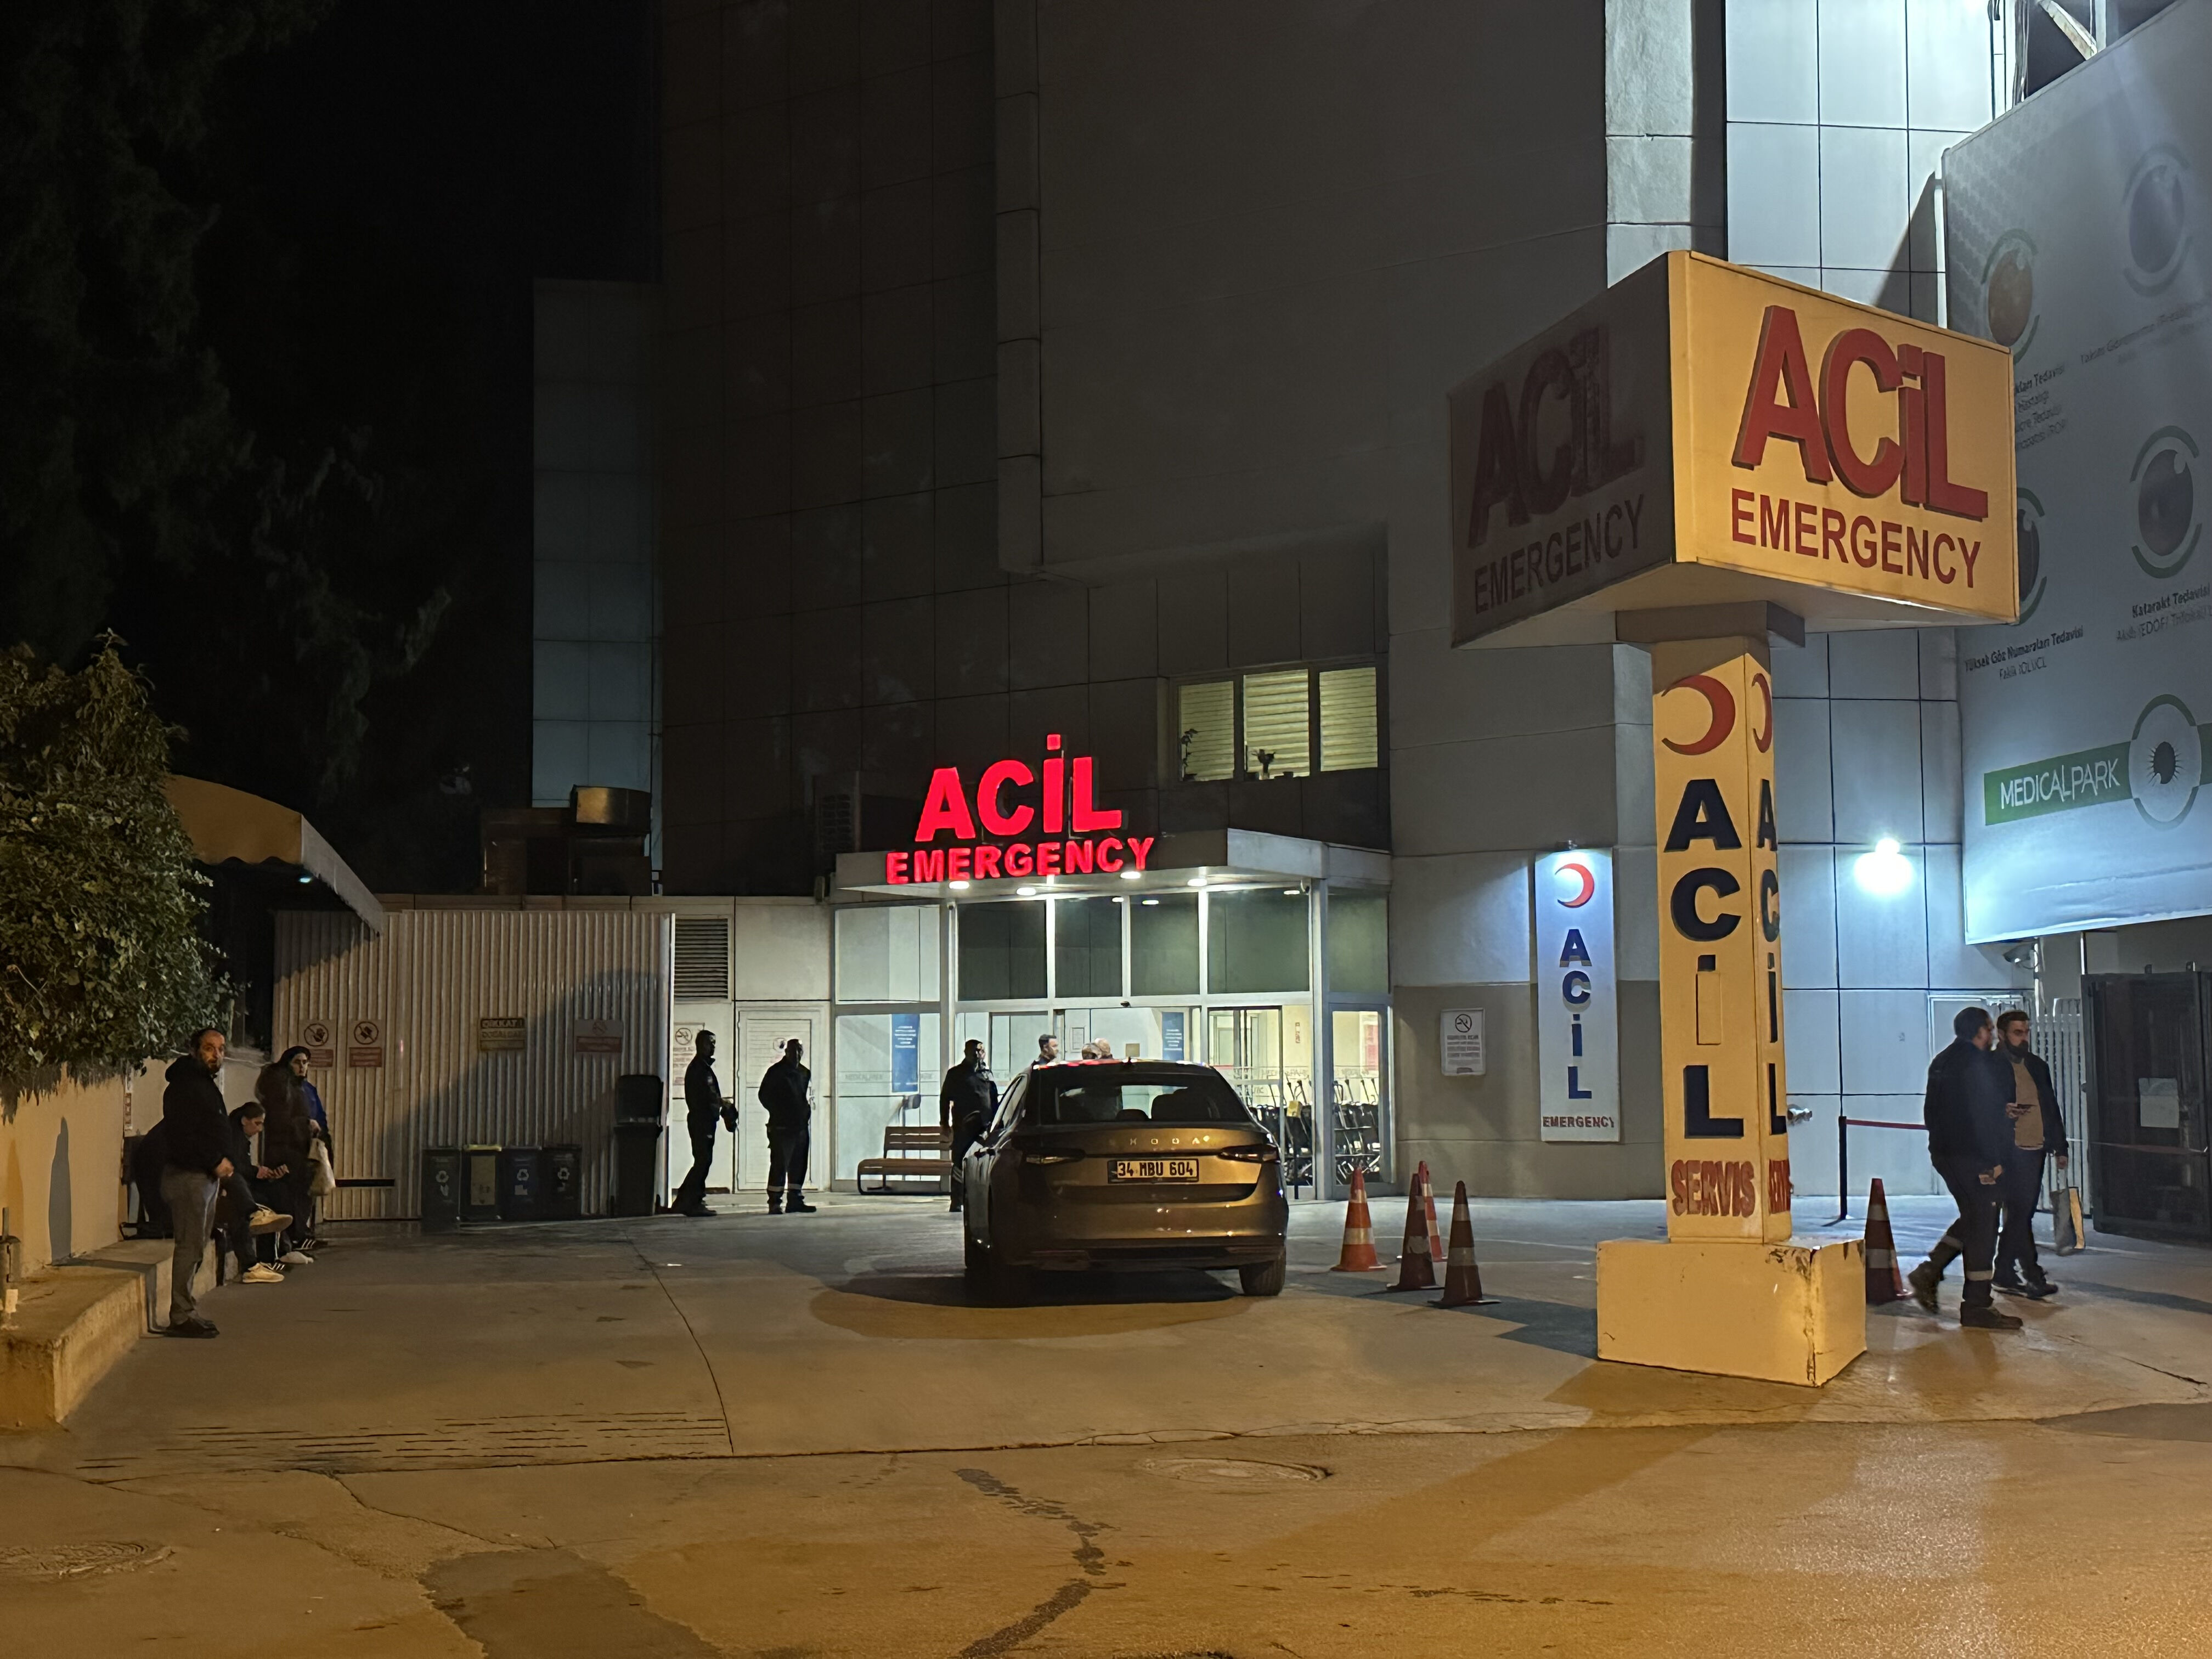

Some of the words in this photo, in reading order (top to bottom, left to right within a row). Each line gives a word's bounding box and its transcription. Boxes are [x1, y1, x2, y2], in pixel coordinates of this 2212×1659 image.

[1475, 494, 1644, 614] EMERGENCY
[1731, 488, 1980, 588] EMERGENCY
[886, 837, 1154, 884] EMERGENCY
[1543, 1116, 1614, 1128] EMERGENCY
[1118, 1162, 1134, 1177] 34
[1139, 1162, 1164, 1176] MBU
[1169, 1162, 1193, 1176] 604
